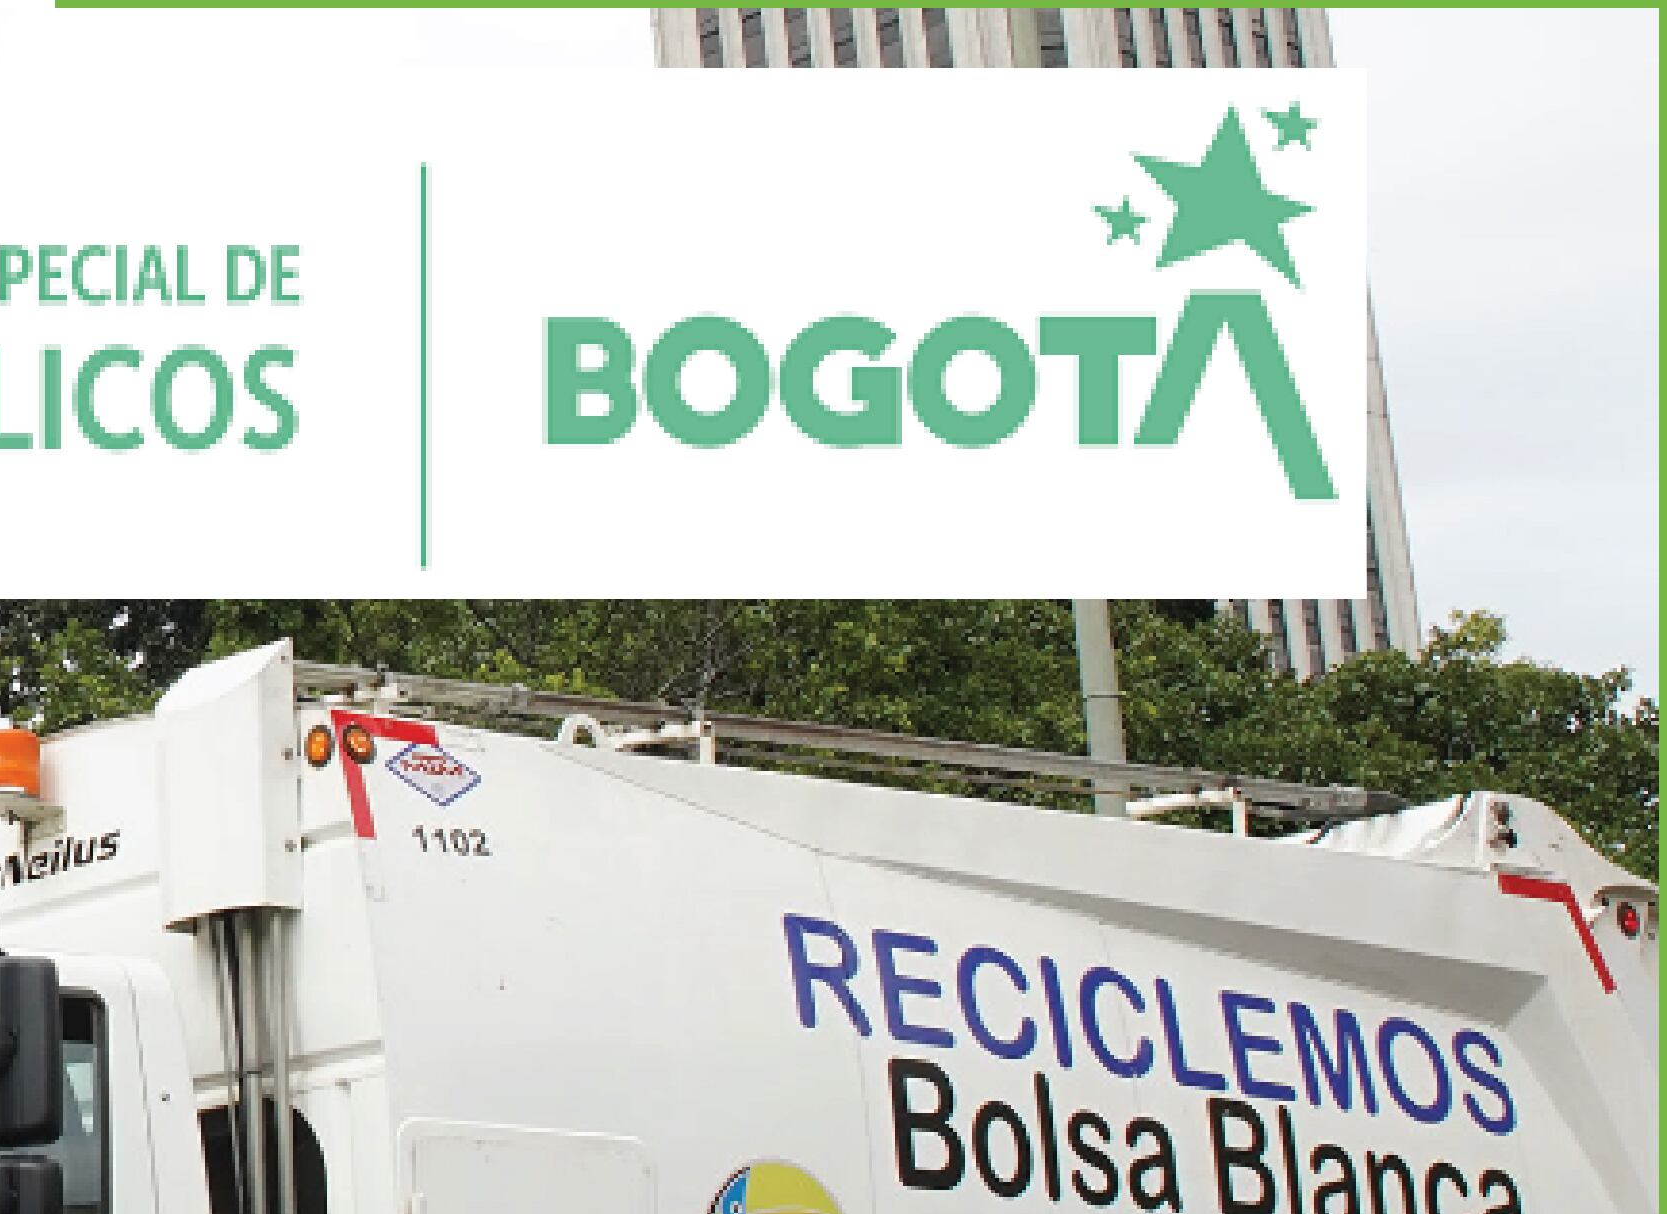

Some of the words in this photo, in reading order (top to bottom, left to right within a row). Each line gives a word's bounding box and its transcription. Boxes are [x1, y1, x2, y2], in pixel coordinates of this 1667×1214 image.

[411, 824, 492, 858] 1102
[783, 912, 1519, 1136] RECICLEMOS
[889, 1057, 1185, 1214] Bolsa
